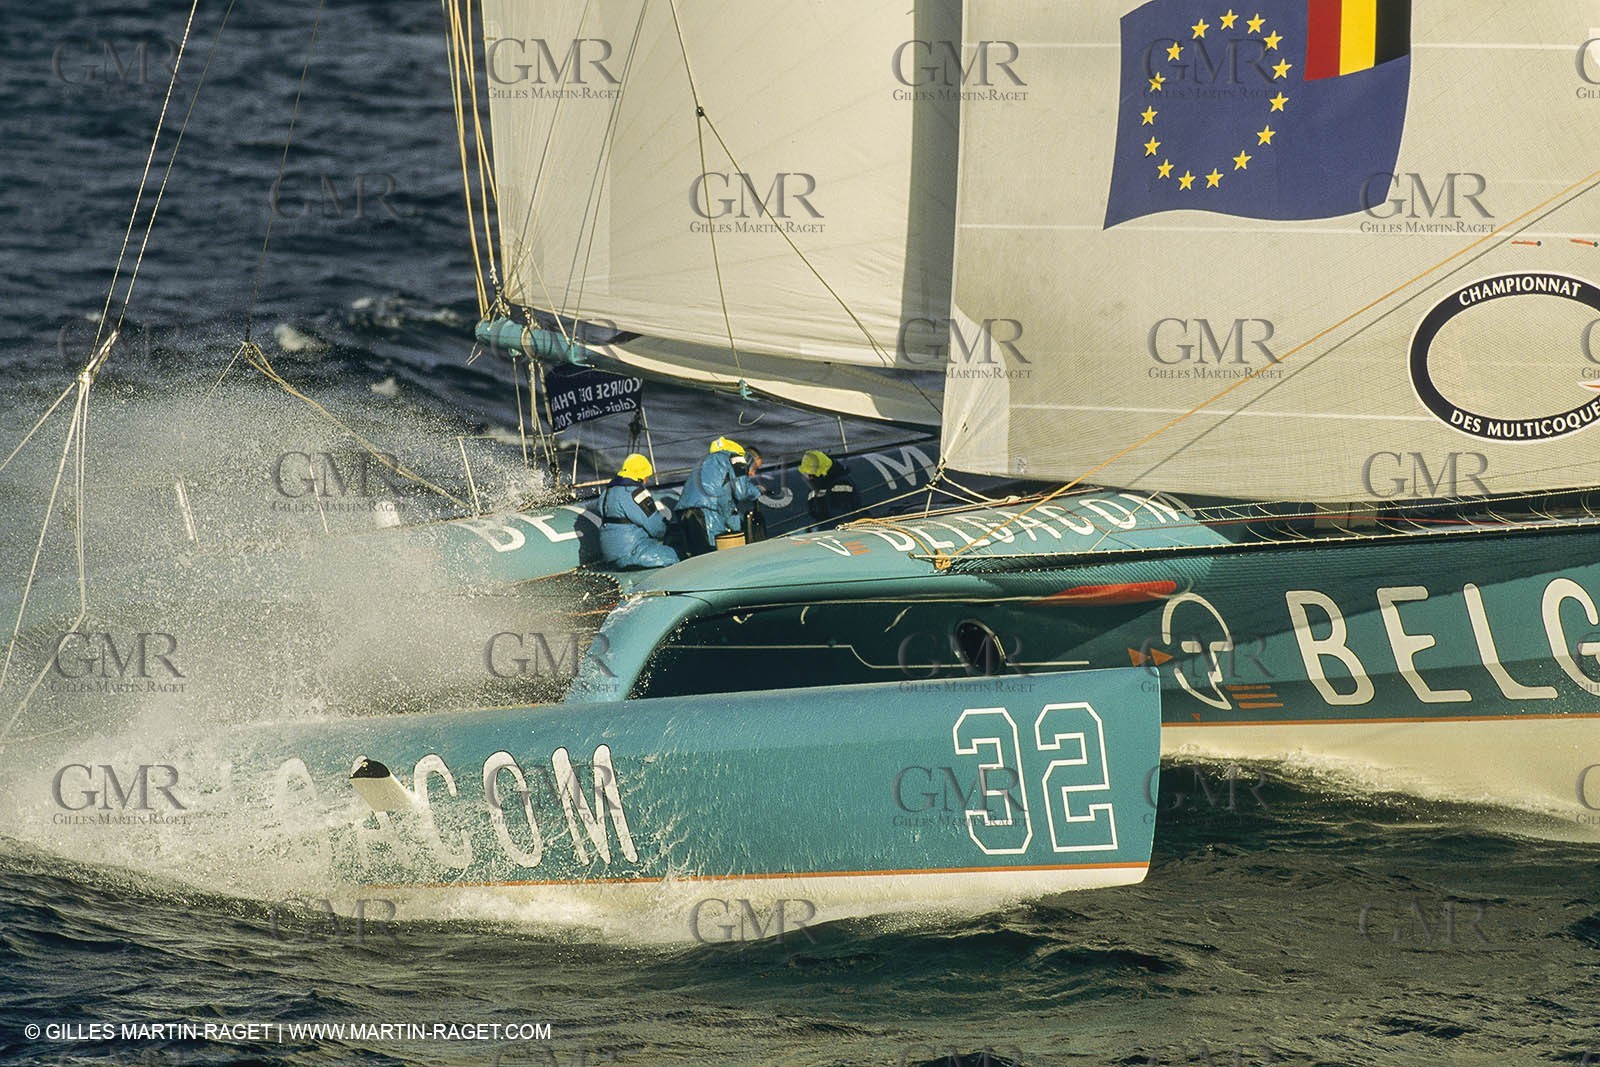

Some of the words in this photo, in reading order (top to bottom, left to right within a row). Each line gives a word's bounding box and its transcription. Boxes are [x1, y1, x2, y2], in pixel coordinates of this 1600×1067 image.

[1459, 276, 1581, 306] CHAMPIONNAT
[1451, 409, 1482, 433] DES
[953, 701, 1119, 854] 32
